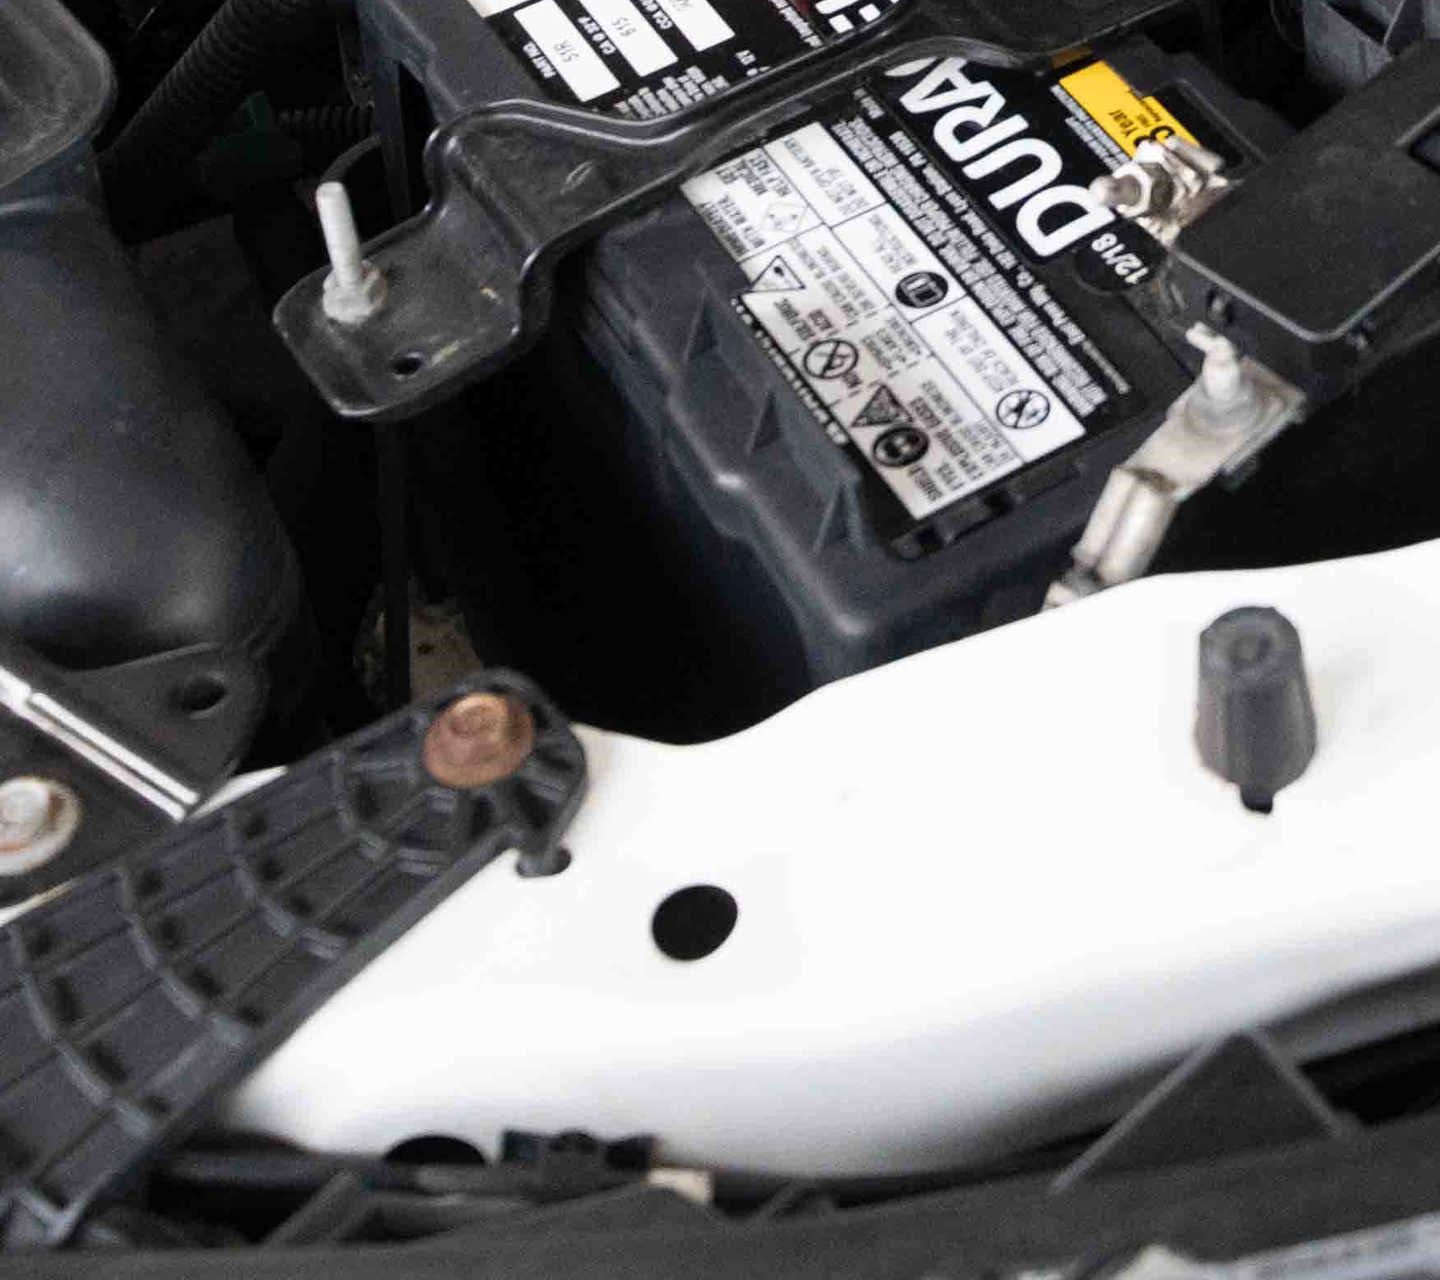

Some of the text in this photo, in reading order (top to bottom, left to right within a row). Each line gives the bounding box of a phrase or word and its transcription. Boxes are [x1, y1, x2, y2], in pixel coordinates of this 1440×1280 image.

[609, 15, 637, 38] 615
[551, 38, 580, 64] 51R
[1105, 104, 1139, 139] Year
[1091, 232, 1149, 284] 12/18
